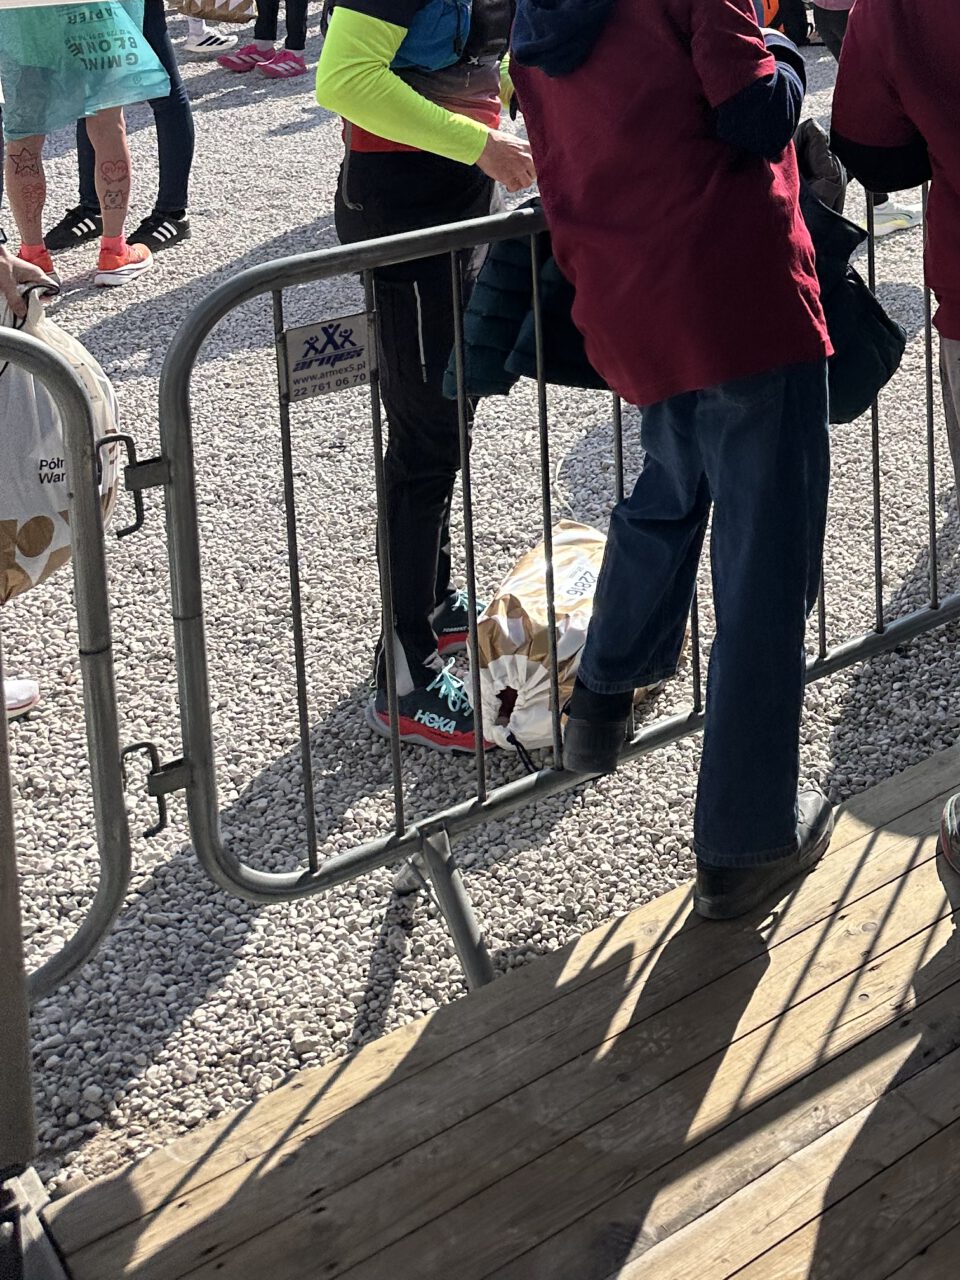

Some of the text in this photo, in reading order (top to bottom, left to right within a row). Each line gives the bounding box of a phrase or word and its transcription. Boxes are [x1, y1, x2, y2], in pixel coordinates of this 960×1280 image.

[294, 373, 366, 397] 22 761 06 70
[414, 709, 457, 735] HOKA
